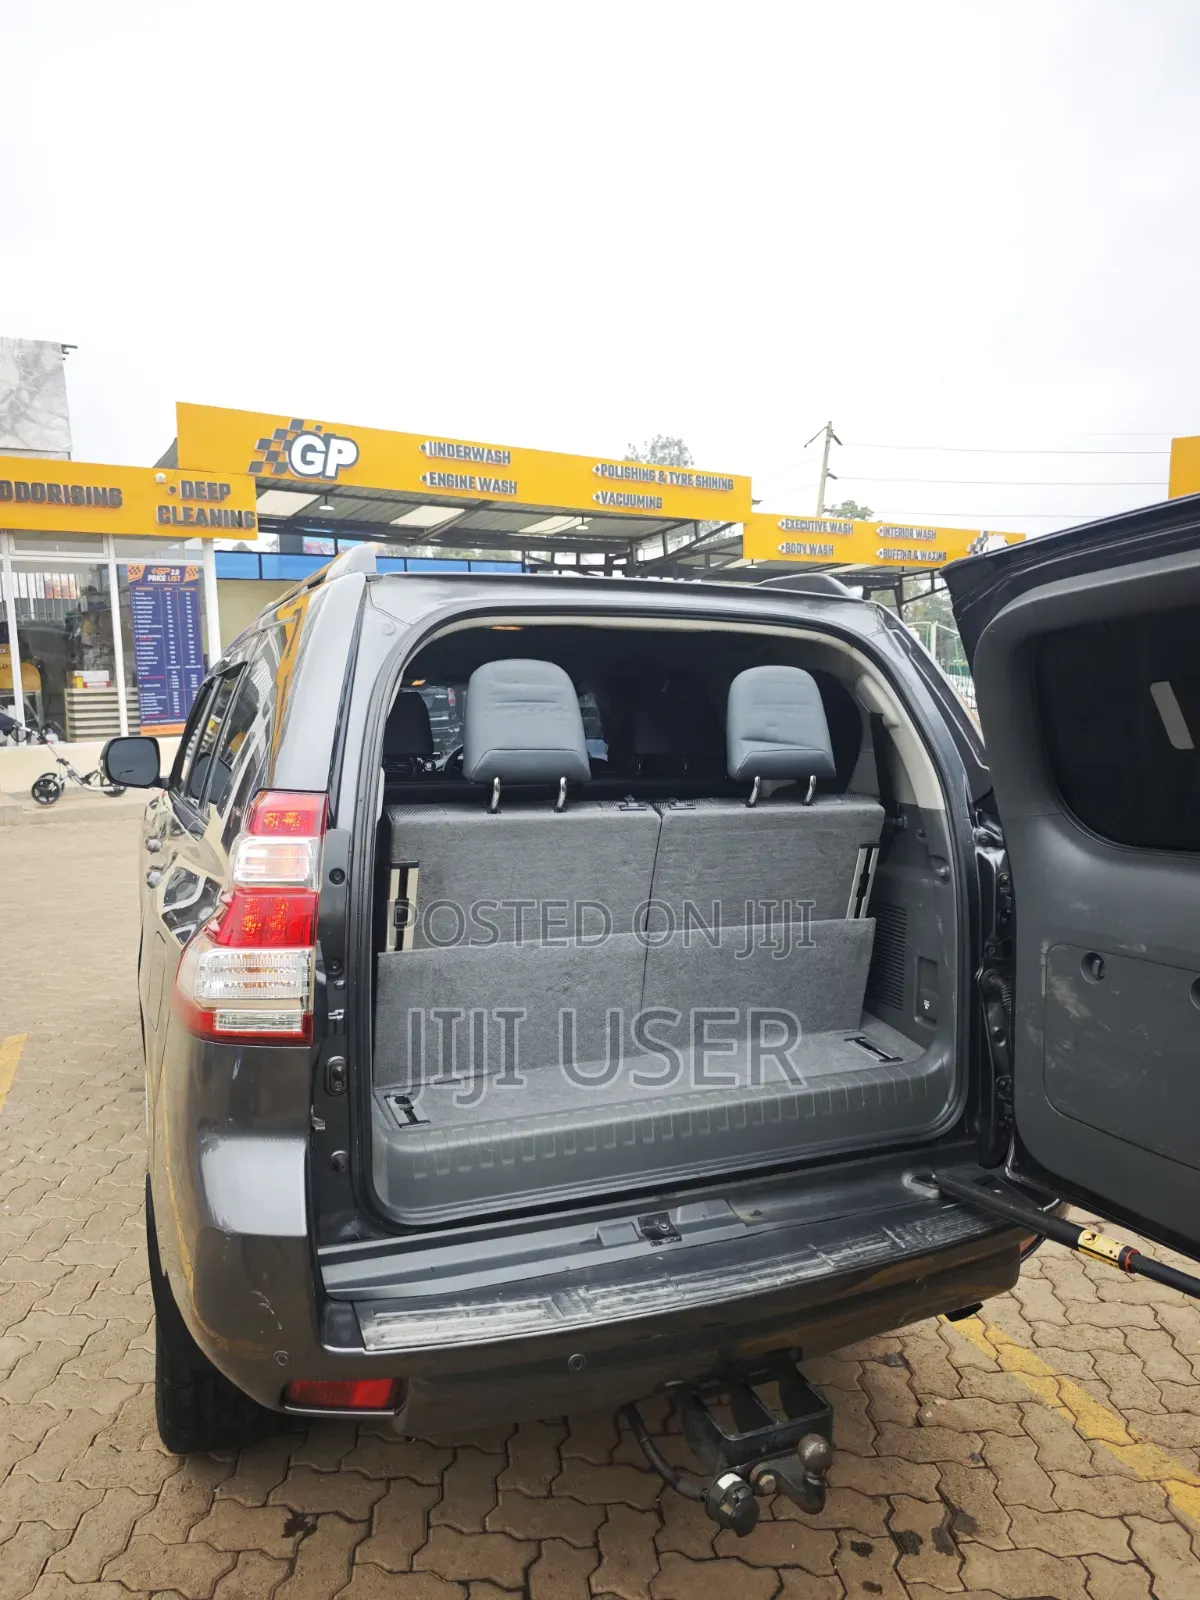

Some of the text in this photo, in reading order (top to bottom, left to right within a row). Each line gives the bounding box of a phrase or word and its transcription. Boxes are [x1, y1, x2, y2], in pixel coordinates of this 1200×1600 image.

[289, 431, 359, 480] GP
[427, 441, 511, 465] UNDERWASH
[428, 472, 517, 494] ENGINE WASH
[600, 463, 734, 490] POLISHING & TYRE SHINING
[0, 480, 123, 508] ODORISING
[180, 480, 231, 501] DEEP
[600, 491, 663, 509] VACUUMING
[157, 505, 256, 528] CLEANING
[785, 519, 853, 534] EXECUTIVE WASH
[883, 526, 937, 540] INTERIOR WASH
[785, 542, 834, 556] BODY WASH
[883, 548, 912, 560] BUFFING
[920, 552, 947, 562] WAXING
[147, 574, 167, 582] PRICE
